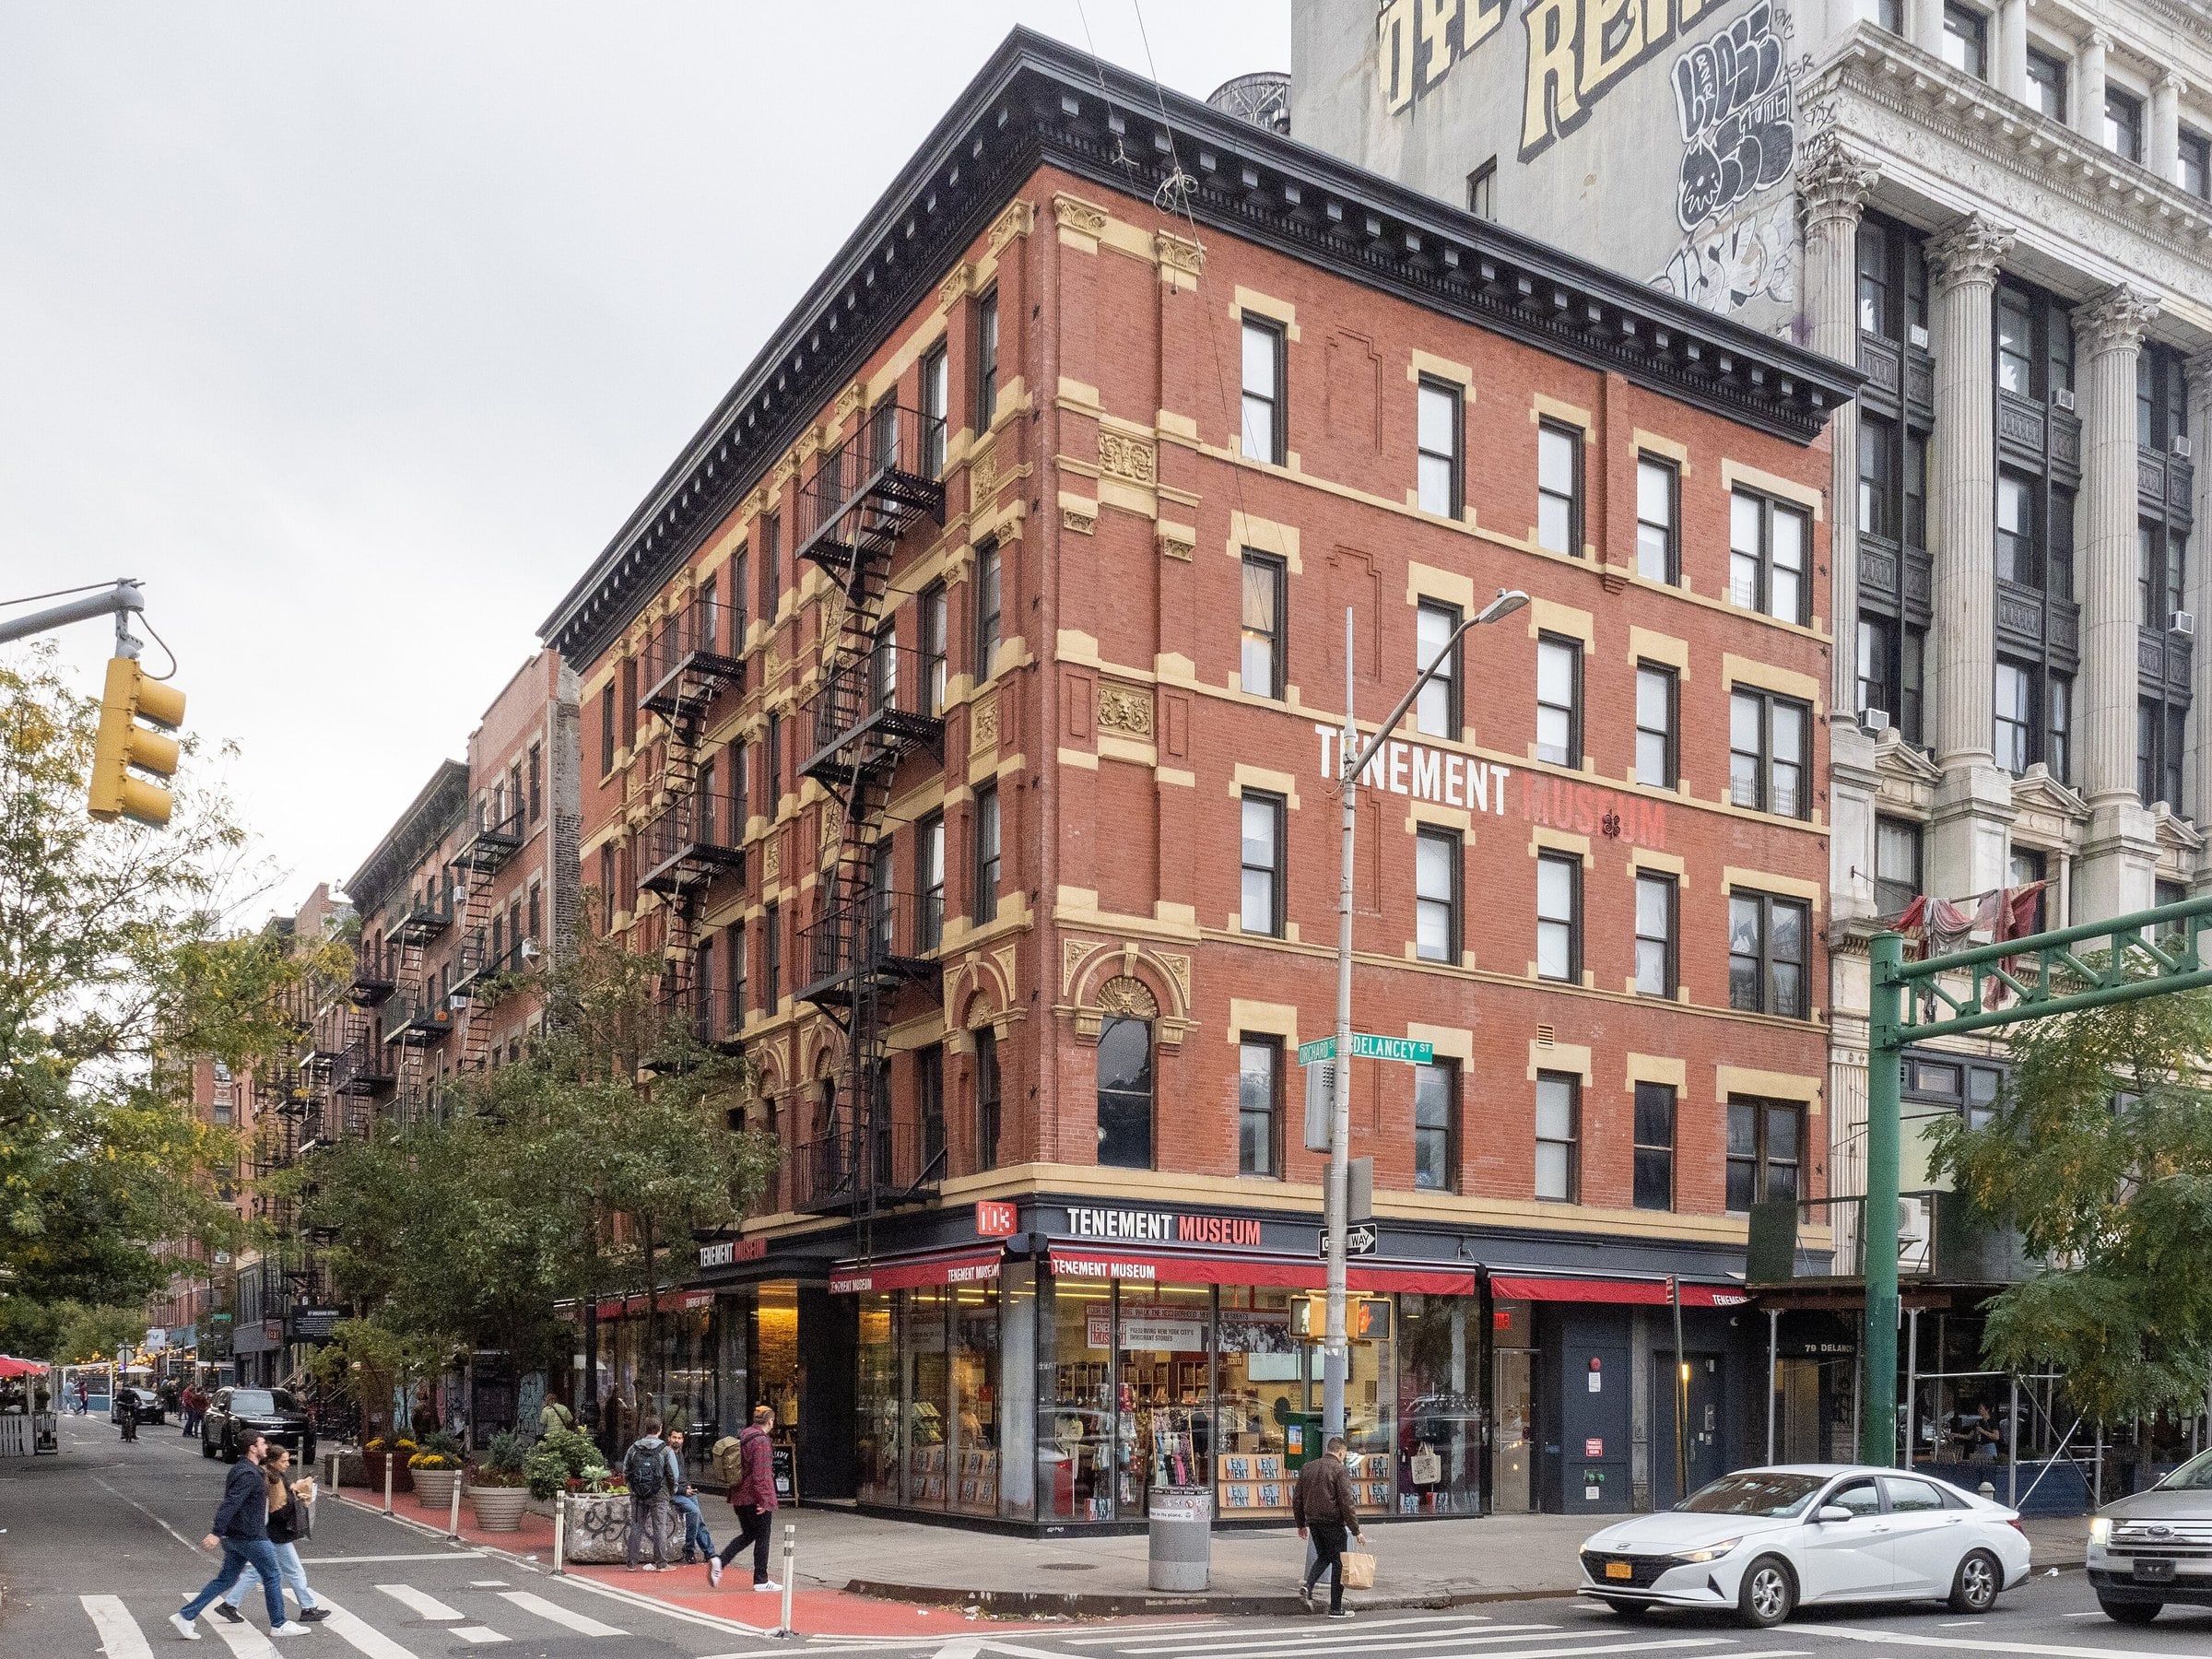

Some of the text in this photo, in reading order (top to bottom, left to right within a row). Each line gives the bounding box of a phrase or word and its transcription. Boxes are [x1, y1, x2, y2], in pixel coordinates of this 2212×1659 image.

[1314, 724, 1510, 816] TNEMENT
[1300, 1041, 1328, 1064] ORCHARD
[1353, 1036, 1430, 1059] DELANCEY ST
[981, 1208, 1010, 1232] 103
[1067, 1207, 1261, 1245] TENEMENT MUSEUM
[1351, 1233, 1370, 1247] WAY
[700, 1238, 768, 1267] TENEMENT MUSEUM
[947, 1267, 975, 1282] TENEMENT
[1053, 1259, 1156, 1279] TENEMENT MUSEUM
[1805, 1344, 1817, 1352] 79
